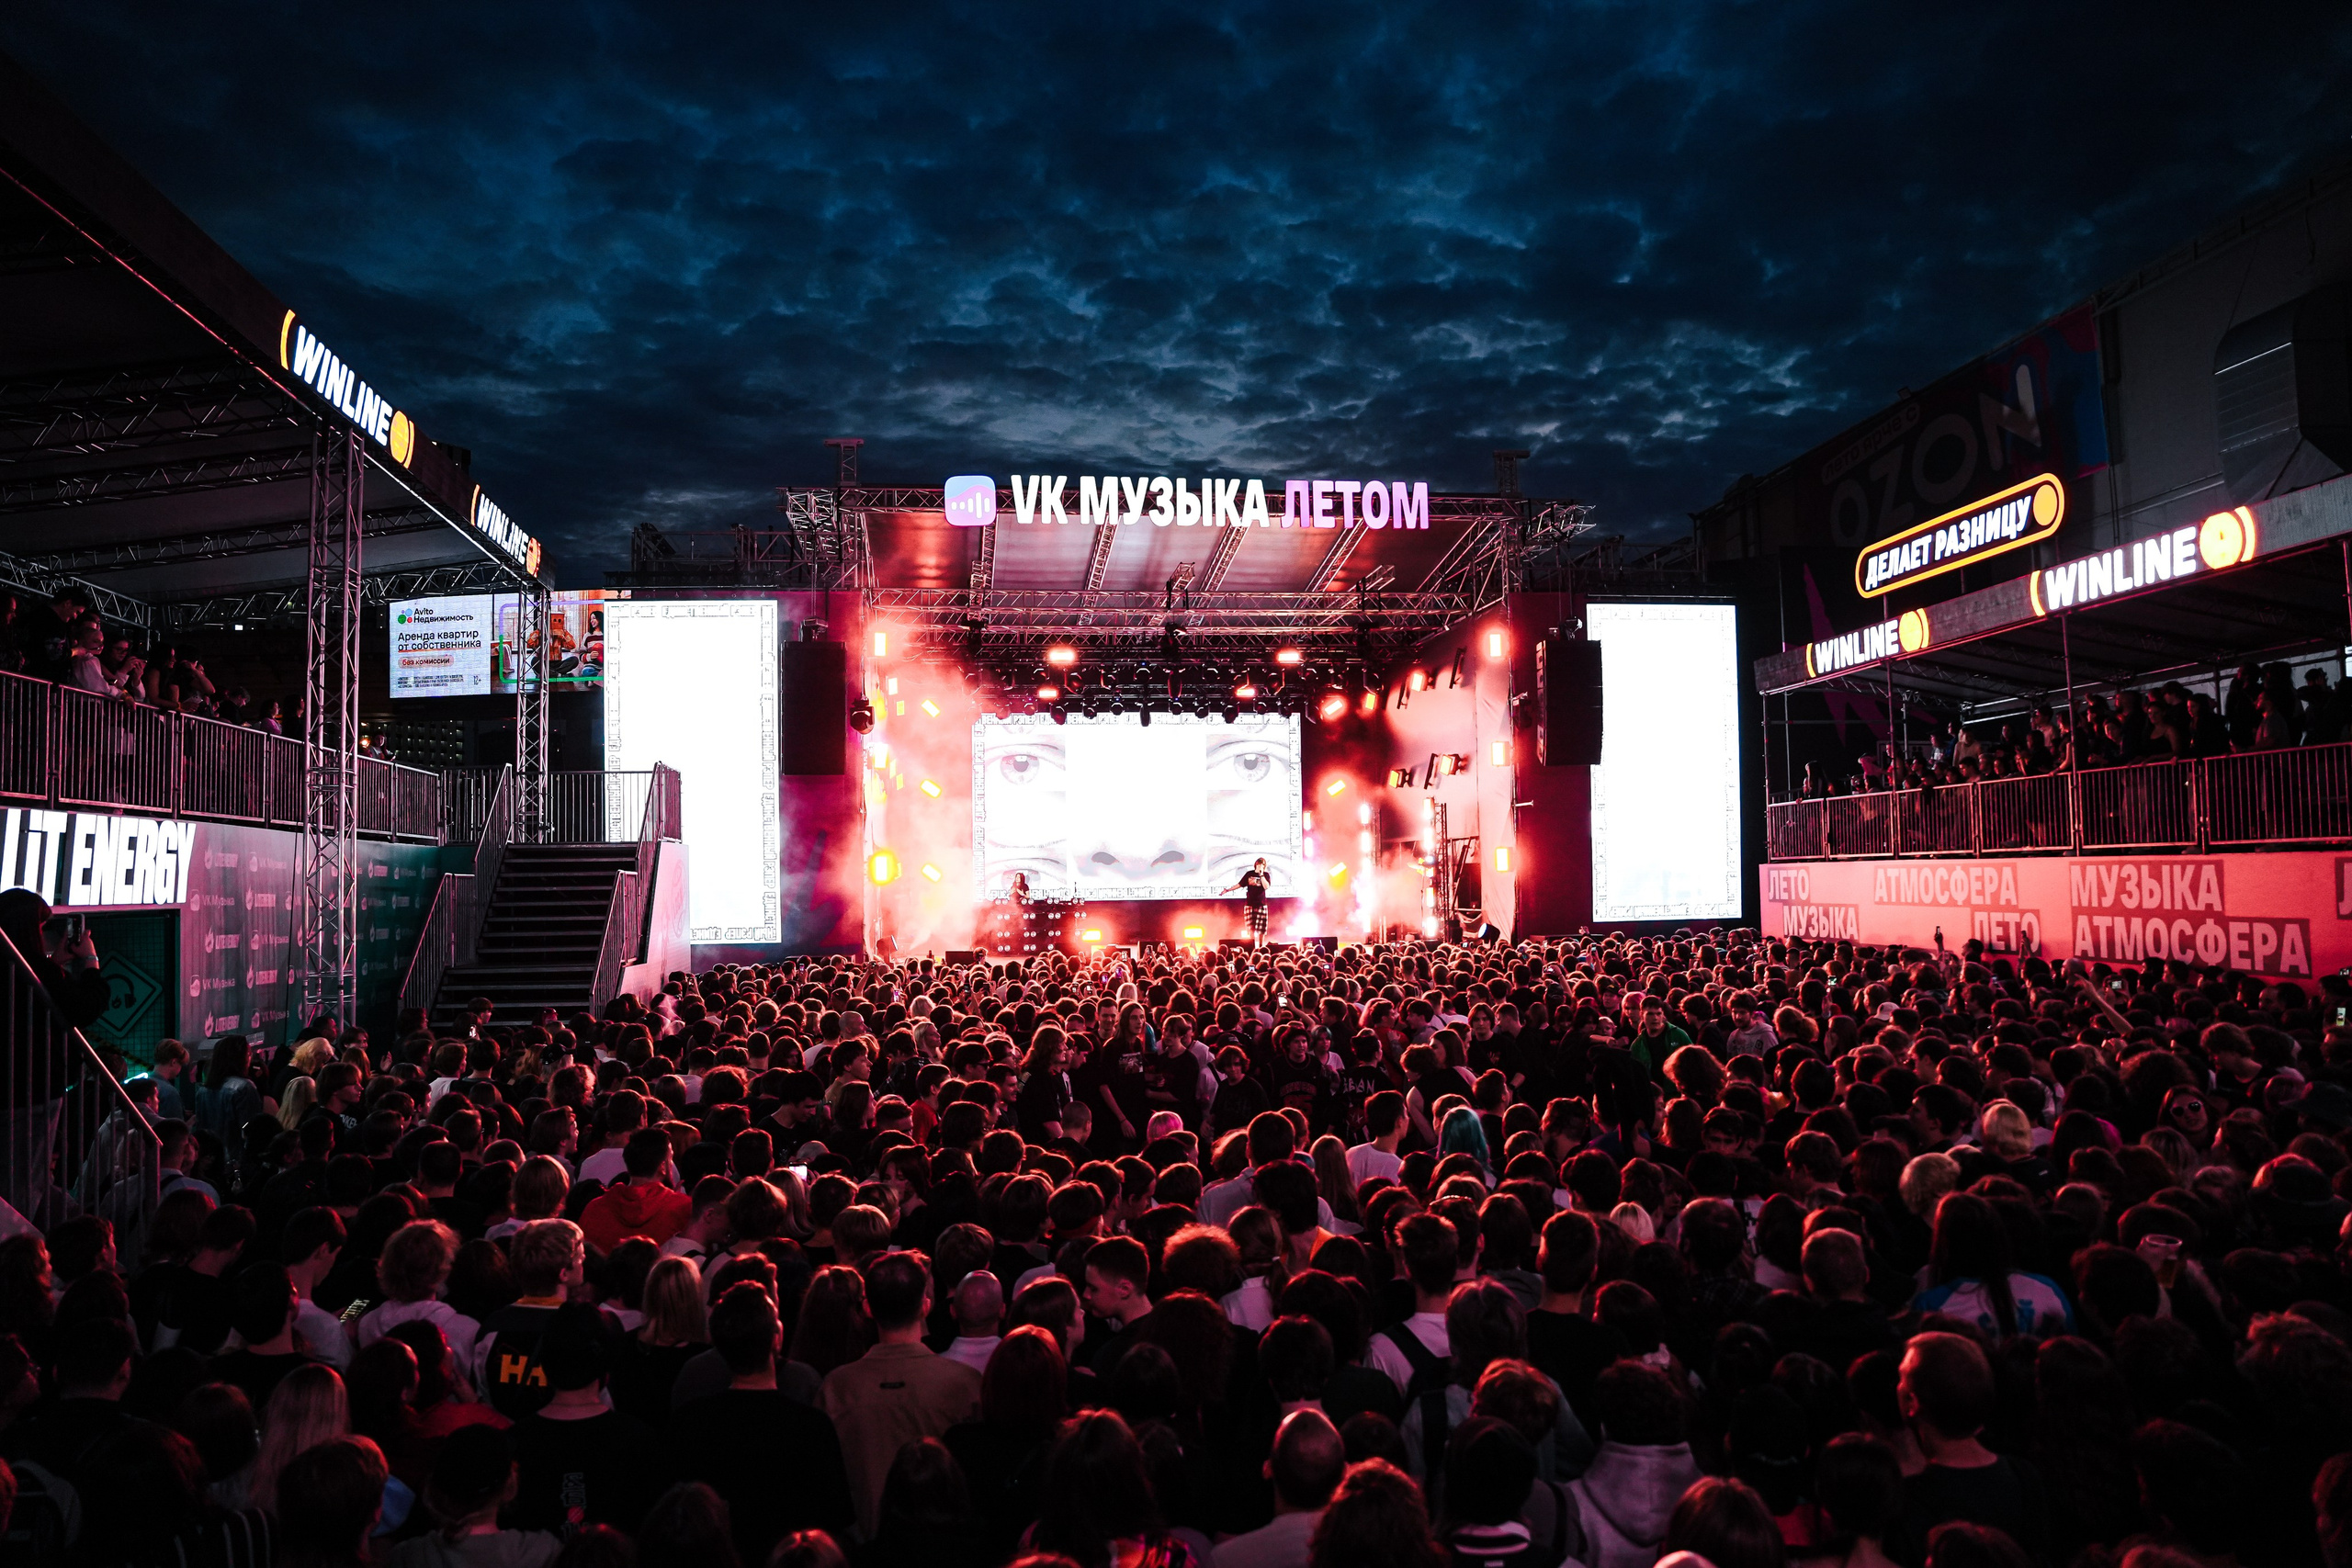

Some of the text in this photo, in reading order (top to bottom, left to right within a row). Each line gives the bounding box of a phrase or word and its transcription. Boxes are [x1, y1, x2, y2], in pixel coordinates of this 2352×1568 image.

[293, 324, 393, 446] WINLINE
[1824, 446, 1860, 479] лето
[1862, 419, 1902, 455] ярче
[1830, 364, 2042, 547] OZON
[477, 493, 529, 565] WINLINE
[1010, 474, 1429, 530] VK МУЗЫКА ЛЕТОМ
[1864, 494, 2031, 591] ДЕЛАЕТ РАЗНИЦУ
[2045, 526, 2196, 610] WINLINE
[398, 630, 479, 642] Аренда квартир
[398, 639, 481, 651] от собственника
[413, 615, 474, 624] Недвижимость
[1815, 619, 1899, 674] WINLINE
[68, 813, 197, 906] ENERGY
[1769, 868, 1810, 901] ЛЕТО
[1874, 865, 2018, 906] АТМОСФЕРА
[2070, 863, 2222, 911] МУЗЫКА
[1782, 905, 1859, 941] МУЗЫКА
[1973, 910, 2041, 953] ЛЕТО
[2075, 915, 2310, 975] АТМОСФЕРА
